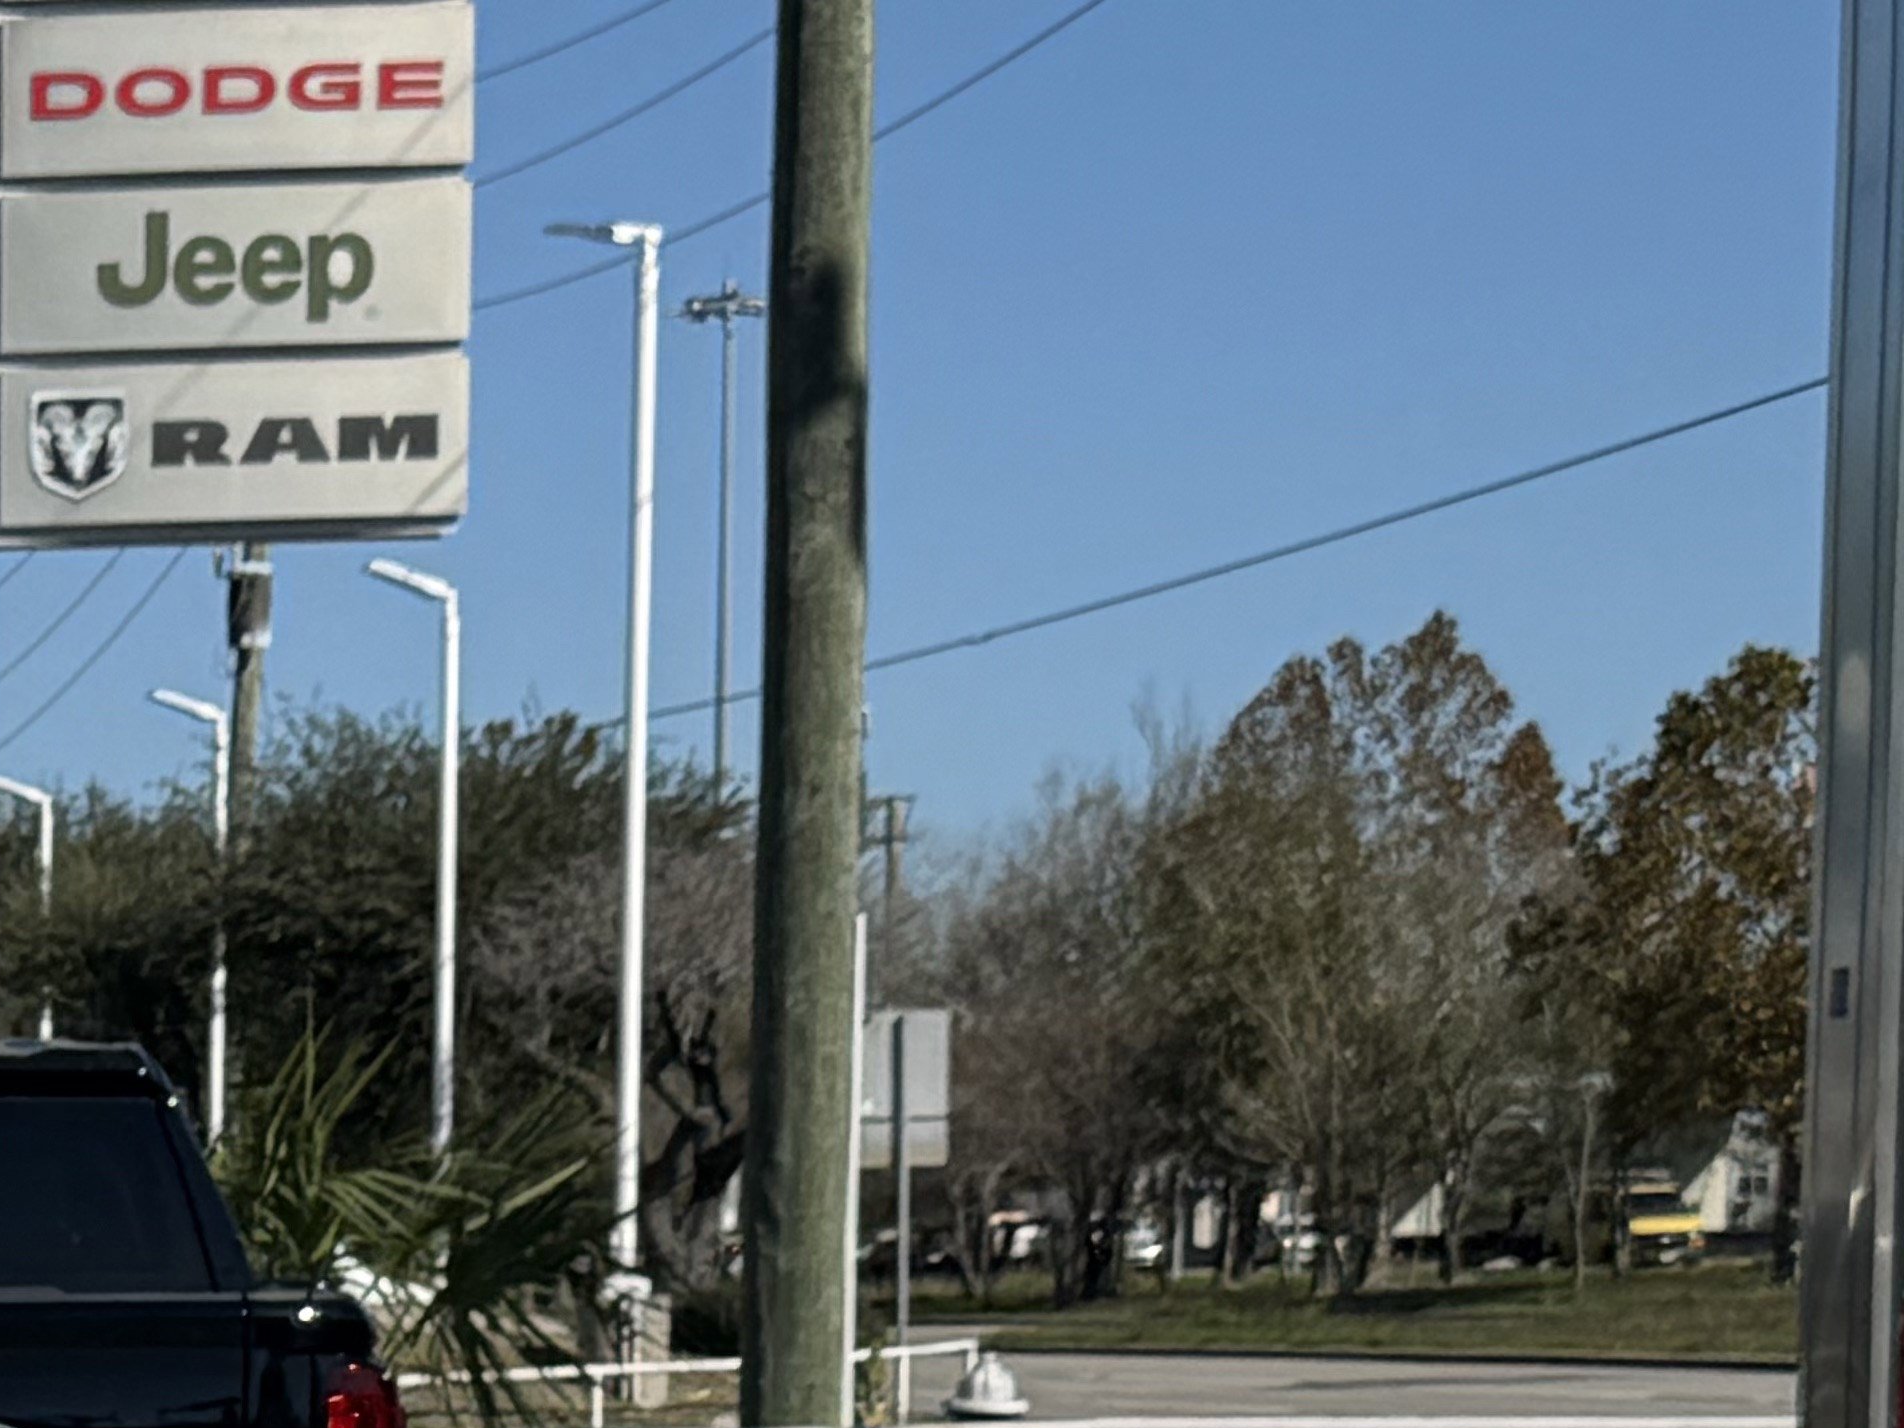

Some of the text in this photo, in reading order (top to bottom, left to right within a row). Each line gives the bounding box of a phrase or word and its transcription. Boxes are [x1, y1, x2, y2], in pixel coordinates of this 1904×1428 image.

[29, 60, 445, 121] DODGE
[97, 210, 374, 323] Jeep
[151, 413, 440, 468] RAM
